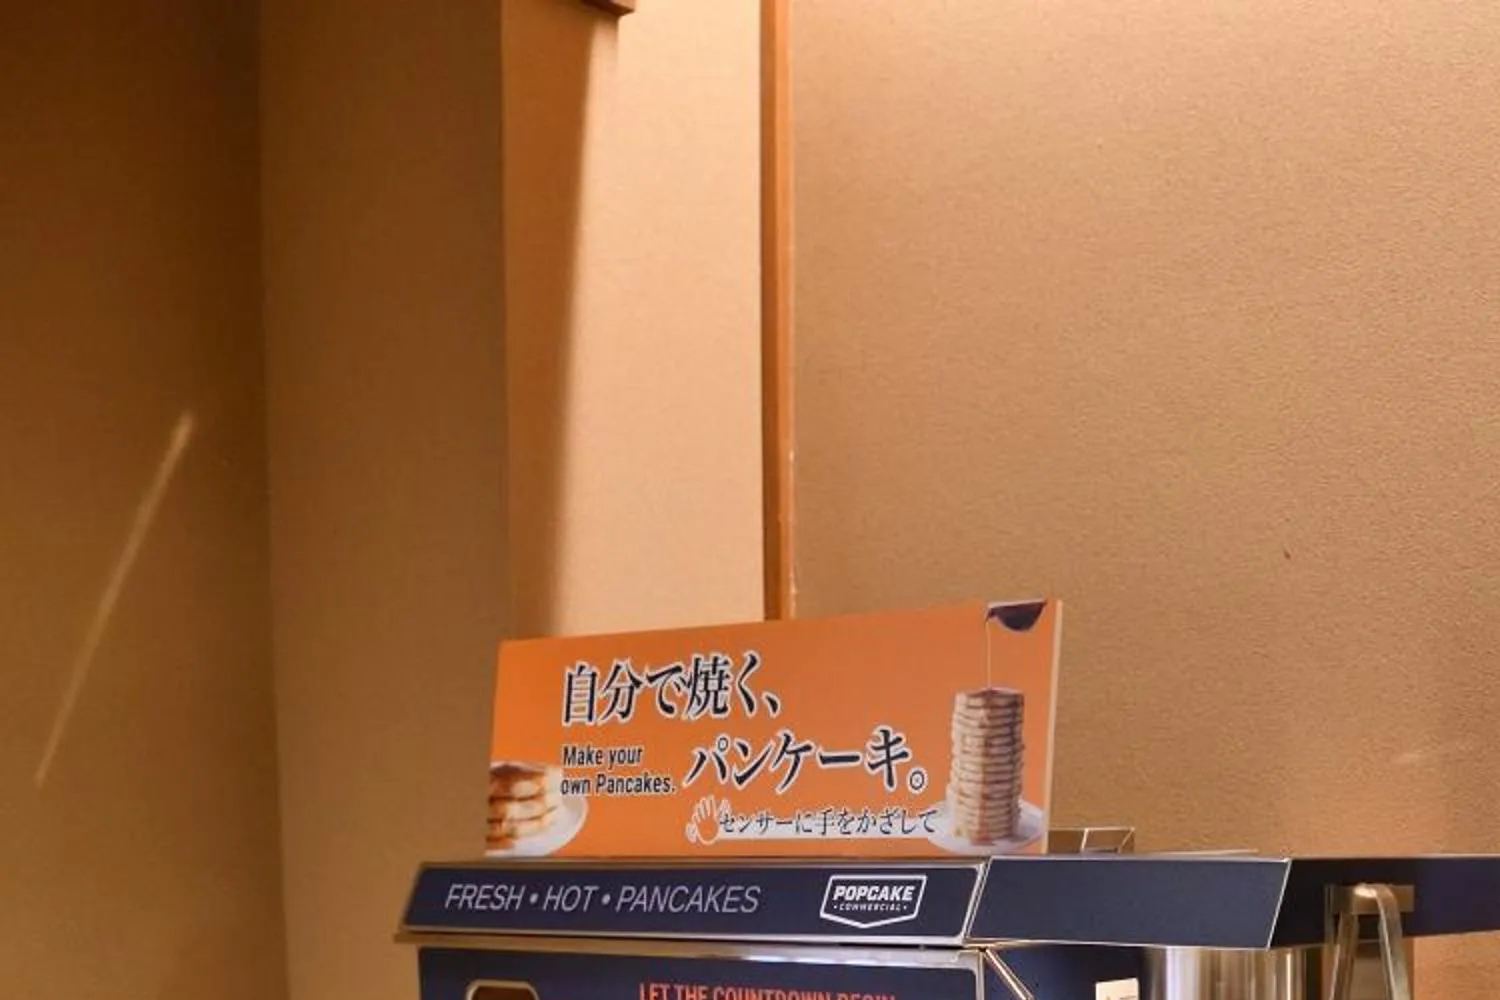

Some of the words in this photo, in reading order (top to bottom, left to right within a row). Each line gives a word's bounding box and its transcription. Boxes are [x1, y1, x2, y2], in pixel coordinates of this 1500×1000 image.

[563, 653, 780, 725] 自分で焼く、
[563, 746, 603, 766] Make
[608, 748, 643, 770] your
[684, 728, 926, 792] パンケーキ。
[560, 776, 591, 795] own
[595, 772, 676, 793] Pancakes.
[719, 808, 938, 835] センサーに手をかざして
[445, 884, 525, 911] FRESH
[543, 886, 598, 912] HOT
[616, 886, 761, 913] PANCAKES
[833, 885, 915, 901] POPCAKE
[839, 903, 901, 911] COMMERCIAL
